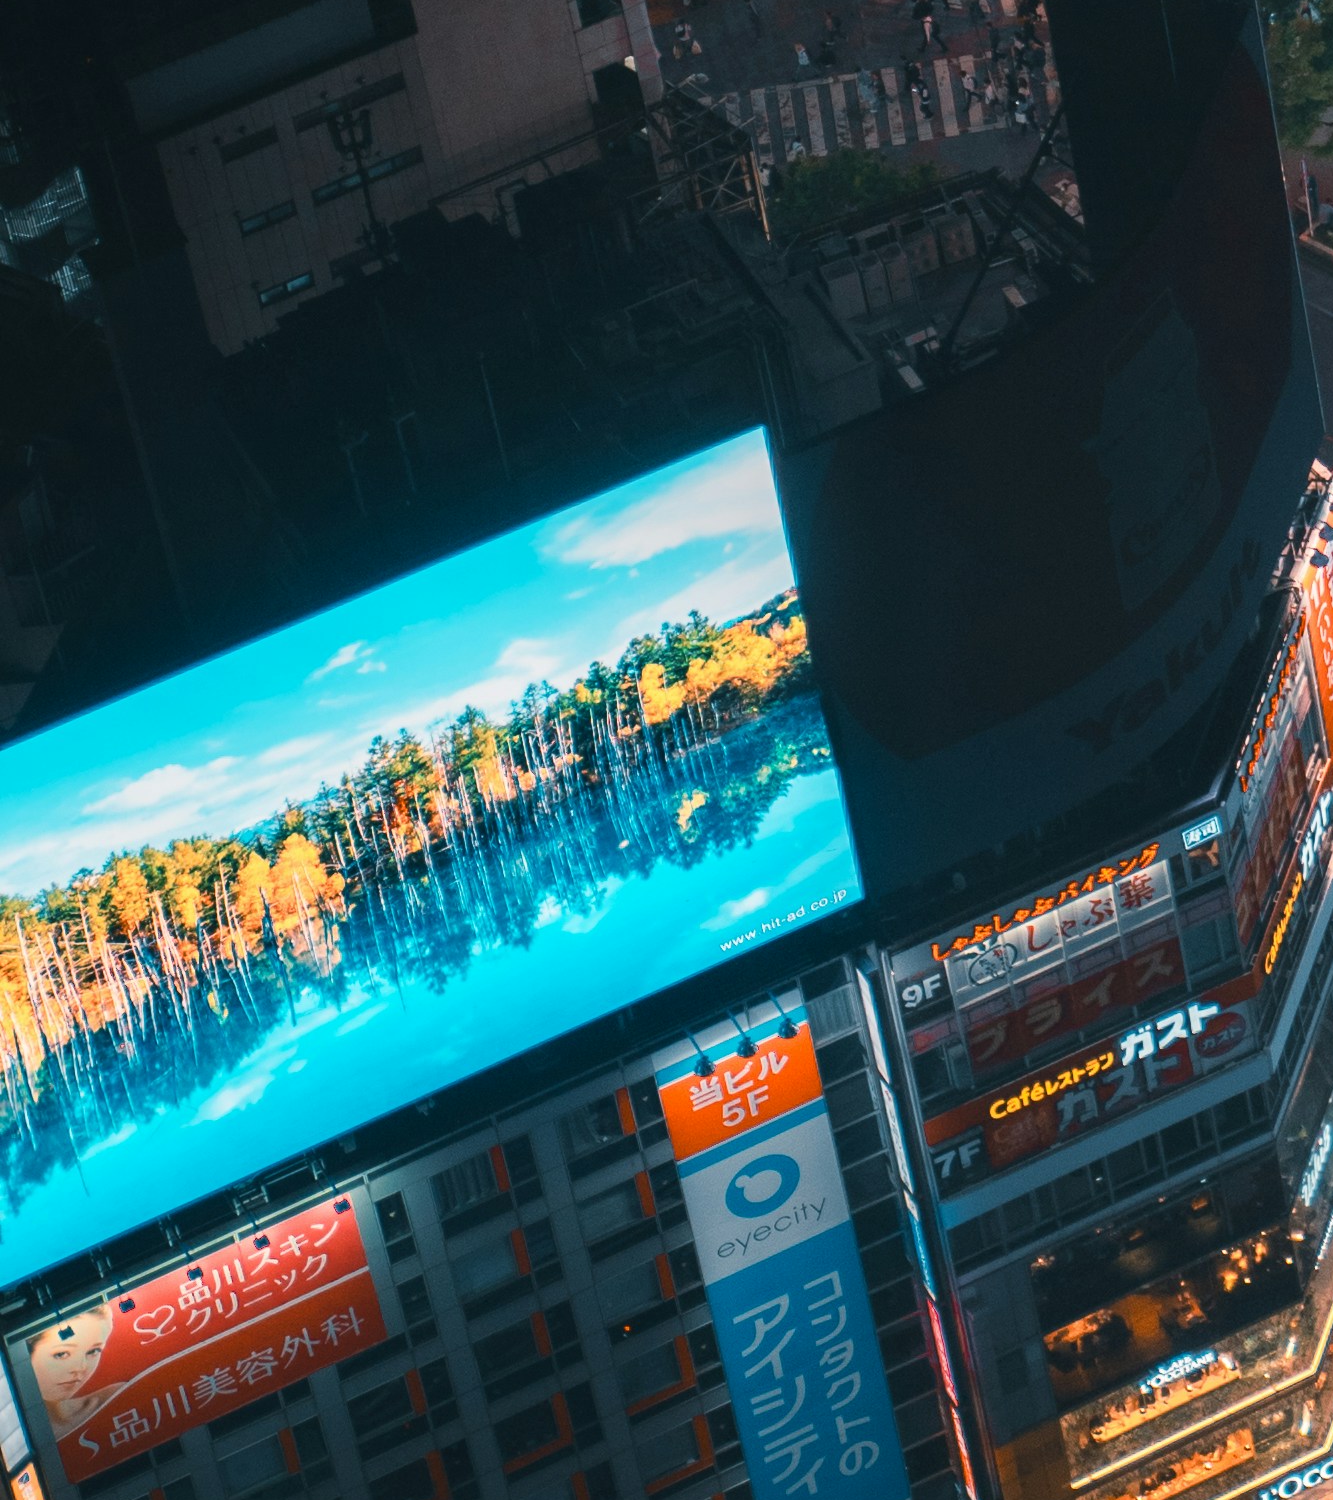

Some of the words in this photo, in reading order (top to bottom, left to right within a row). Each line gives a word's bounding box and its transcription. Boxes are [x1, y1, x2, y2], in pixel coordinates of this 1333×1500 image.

[718, 888, 849, 953] www.hit-ad.co.jp
[931, 842, 1161, 962] しゃぶしゃぶバイキング
[1025, 872, 1156, 953] しゃぶ葉
[901, 973, 942, 1009] 9F
[1120, 1000, 1221, 1066] ガスト
[688, 1048, 788, 1114] 当ビル
[721, 1086, 769, 1129] 5F
[934, 1137, 981, 1180] 7F
[177, 1218, 342, 1310] 品川スキン
[717, 1196, 828, 1261] eyecity
[187, 1252, 329, 1335] クリニック
[109, 1305, 366, 1451] 品川美容外科
[733, 1292, 820, 1498] アイシティ
[803, 1269, 882, 1477] コンタクトの
